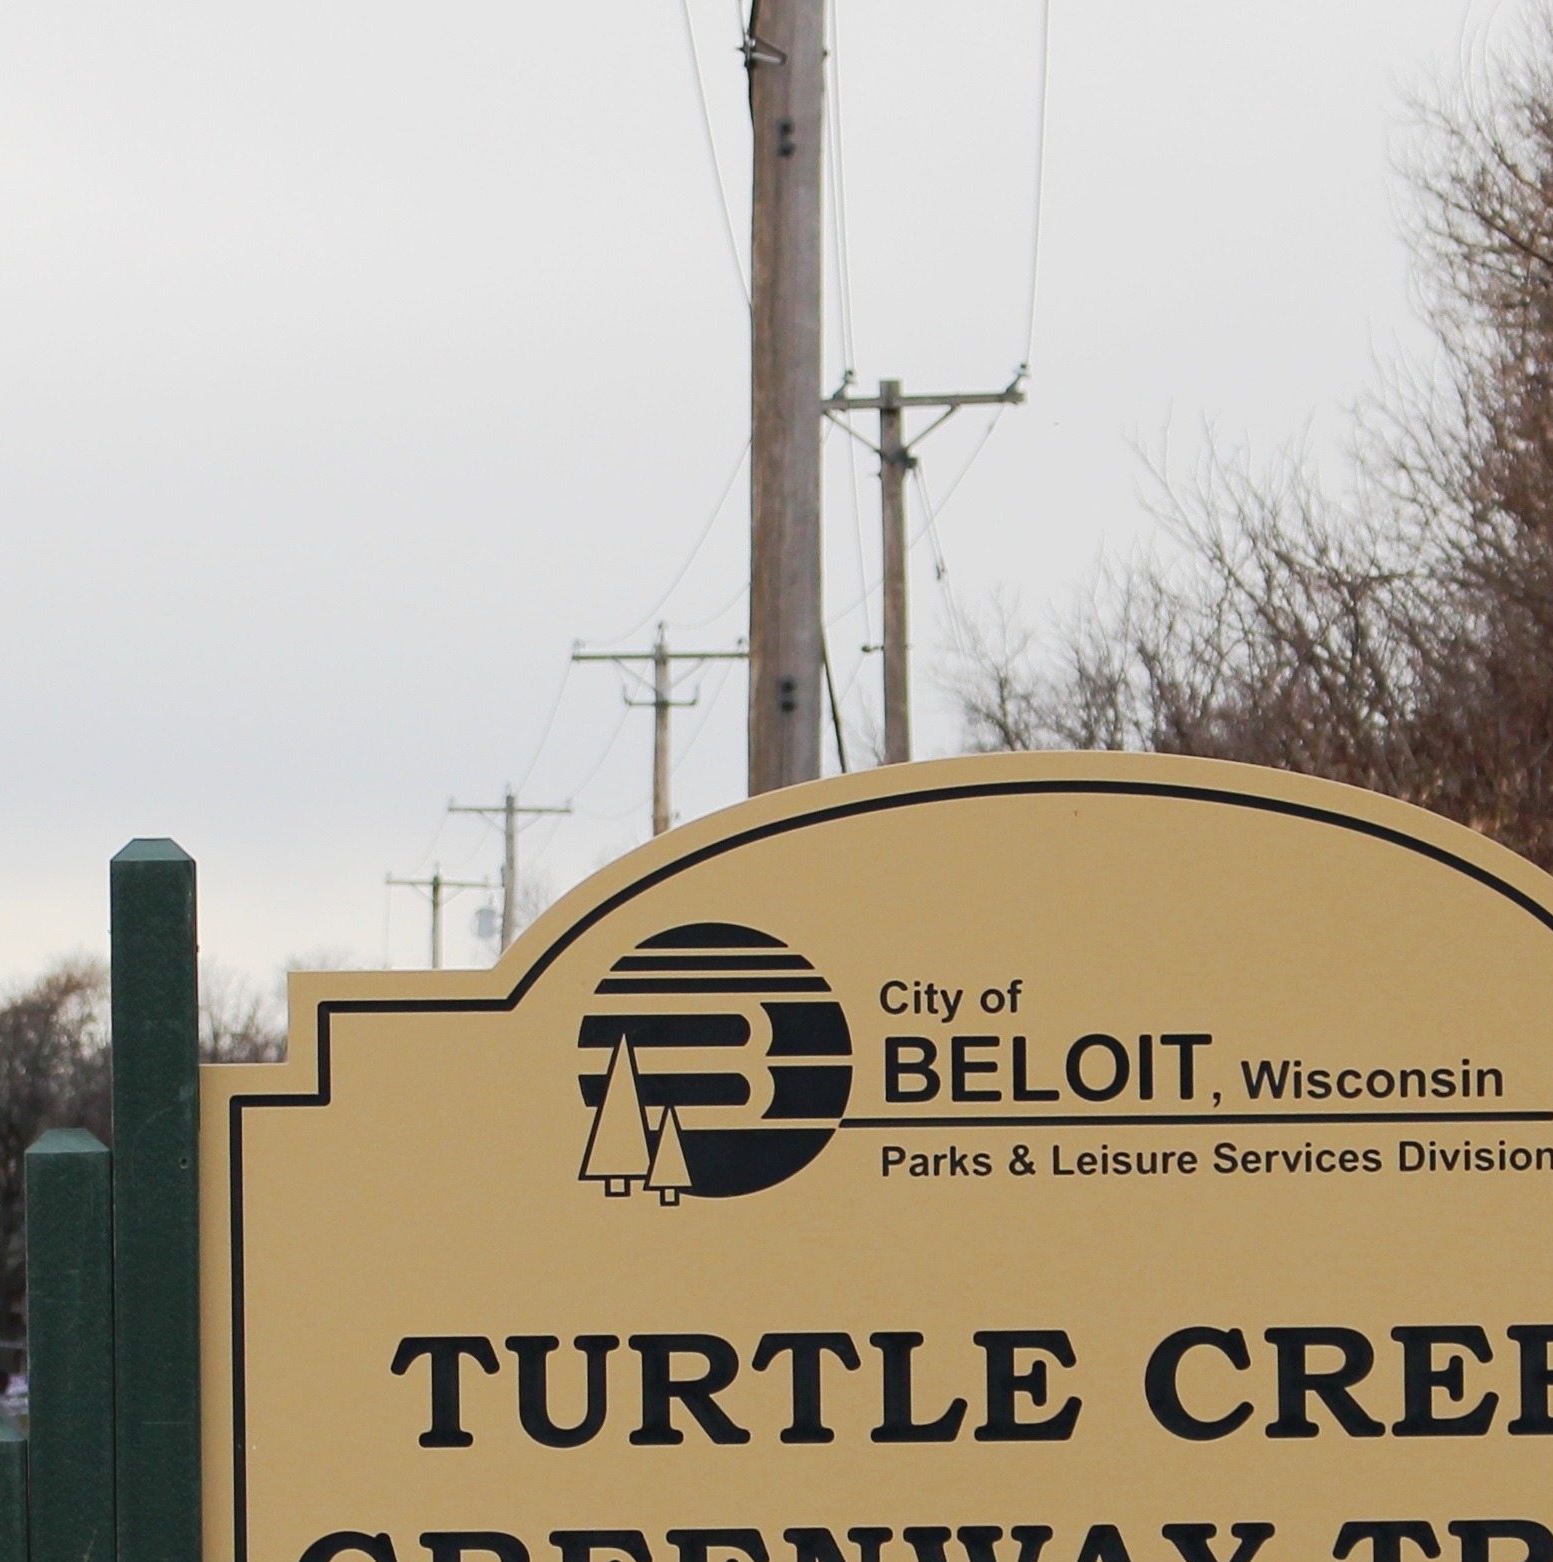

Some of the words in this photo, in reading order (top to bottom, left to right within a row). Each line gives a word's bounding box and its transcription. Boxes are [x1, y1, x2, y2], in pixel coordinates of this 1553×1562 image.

[878, 979, 964, 1025] City
[978, 978, 1024, 1015] of
[883, 1032, 1223, 1109] BELOIT,
[1239, 1057, 1504, 1101] Wisconsin
[881, 1144, 994, 1178] Parks
[1007, 1143, 1037, 1177] &
[1051, 1143, 1199, 1177] Leisure
[1212, 1140, 1384, 1175] Services
[389, 1329, 1084, 1449] TURTLE
